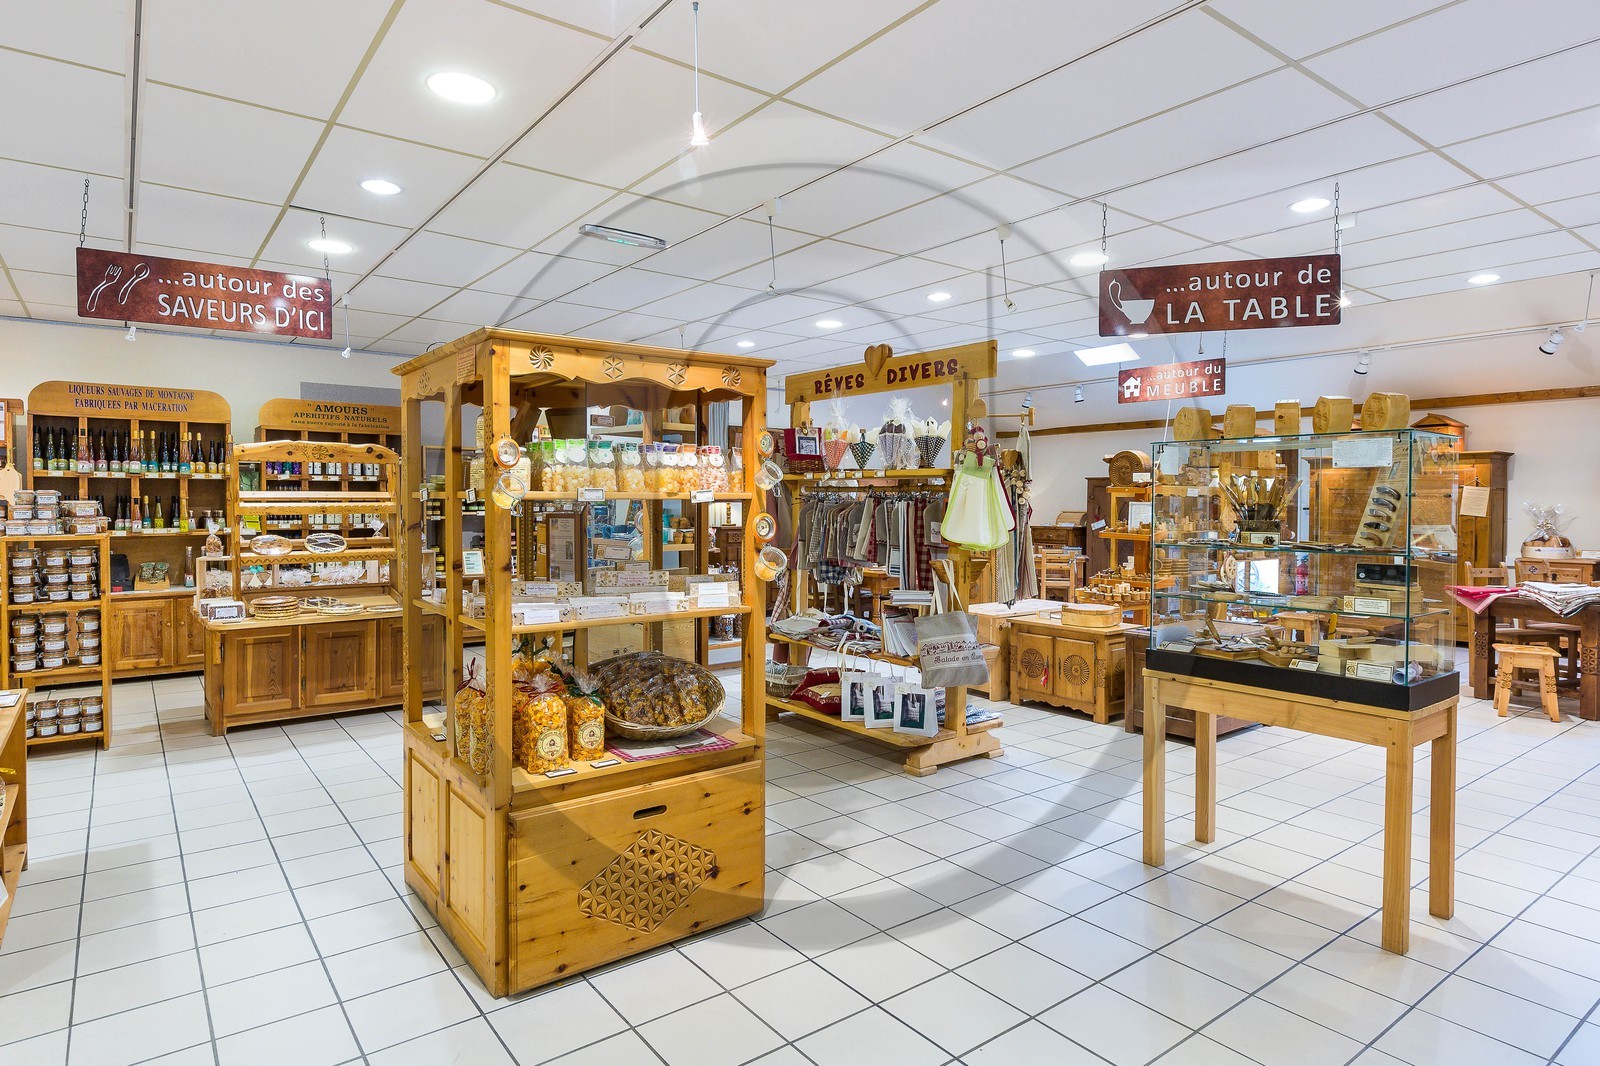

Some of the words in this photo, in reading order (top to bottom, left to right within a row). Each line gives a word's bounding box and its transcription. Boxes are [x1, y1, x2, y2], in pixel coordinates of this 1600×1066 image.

[1297, 263, 1332, 285] de
[282, 280, 325, 302] des
[158, 293, 266, 326] SAVEURS
[275, 306, 324, 332] D'ICI
[1166, 301, 1205, 325] LA
[1222, 294, 1331, 322] TABLE
[886, 358, 959, 385] DIVERS
[1204, 363, 1221, 374] du
[68, 384, 104, 395] LIQUEURS
[107, 386, 142, 397] SAUVAGES
[145, 389, 154, 398] DE
[157, 390, 194, 399] MONTAGNE
[1146, 378, 1222, 398] MEUBLE
[74, 398, 121, 409] FABRIQUEES
[124, 401, 138, 410] PAR
[141, 402, 188, 412] MACERATION
[314, 404, 367, 414] AMOURS
[293, 411, 340, 420] APERITIFS
[344, 415, 387, 423] NATURELS
